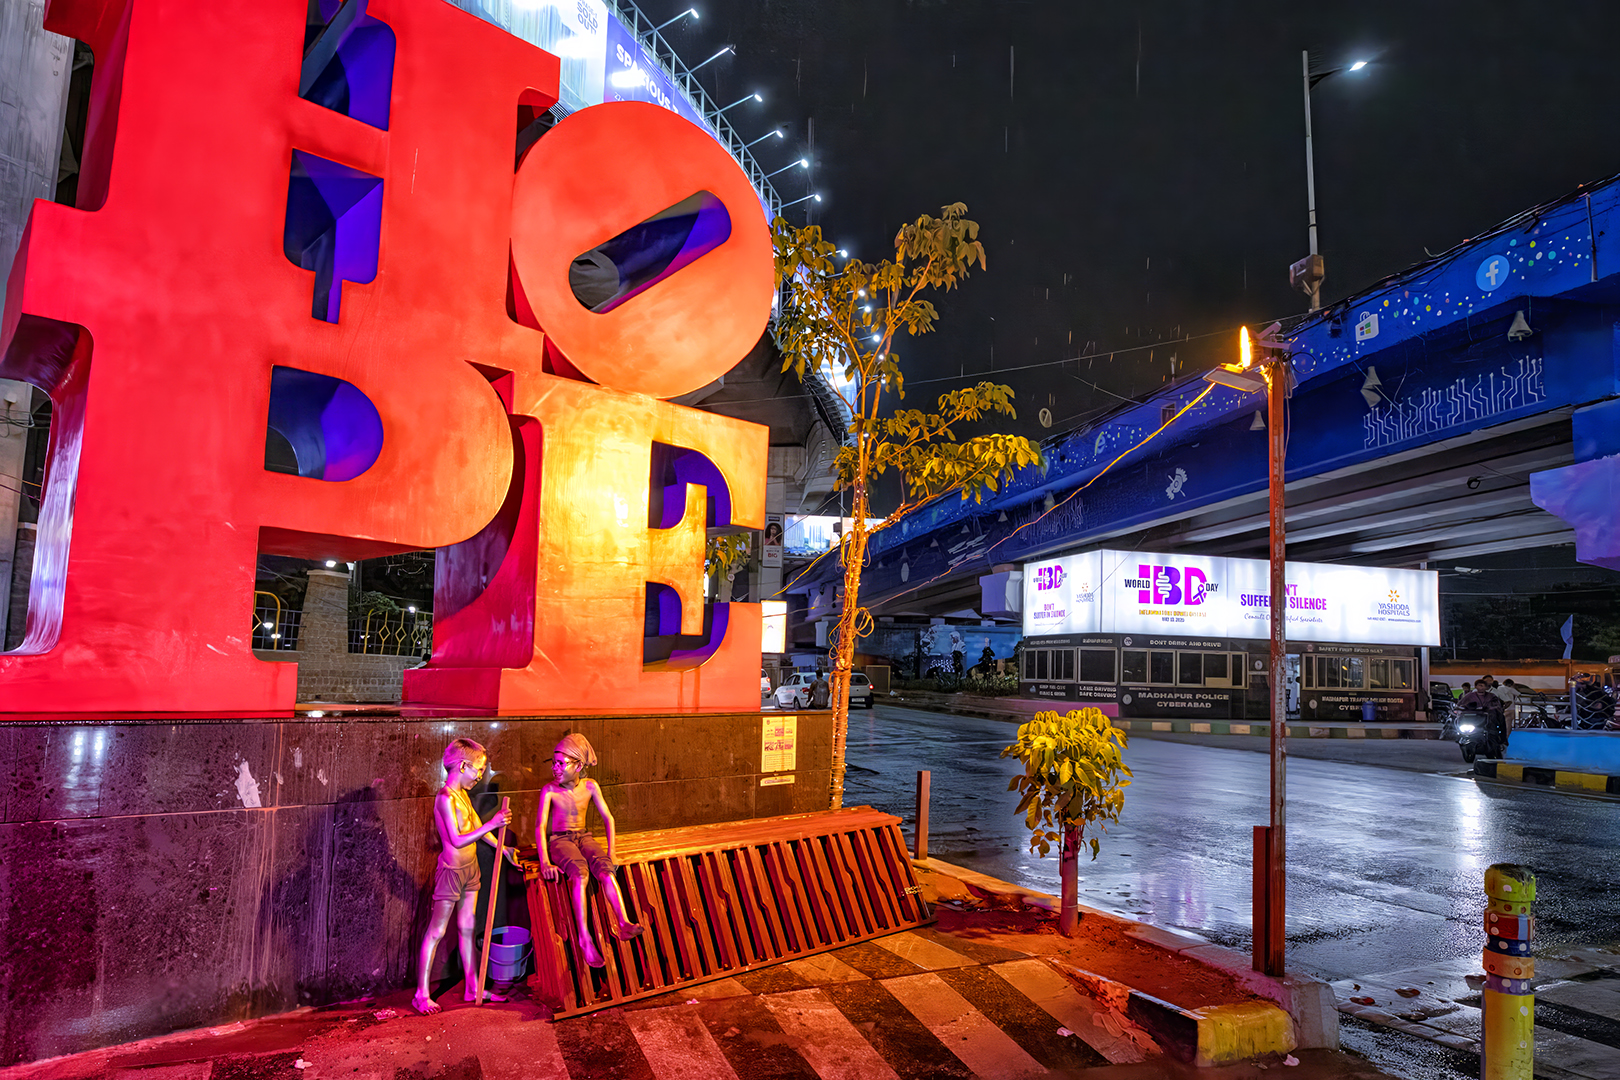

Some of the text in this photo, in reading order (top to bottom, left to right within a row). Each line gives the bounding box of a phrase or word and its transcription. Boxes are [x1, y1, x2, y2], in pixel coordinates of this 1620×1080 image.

[576, 1, 598, 29] SOLD
[616, 43, 671, 111] SPAIOUS
[1124, 564, 1219, 606] WORLD IBD DAY
[1284, 583, 1298, 596] N'T
[1240, 593, 1272, 608] SUFFE
[1289, 596, 1328, 611] SILENCE
[1377, 602, 1410, 610] YASHODA
[1377, 609, 1411, 617] HOSPITALS
[1138, 692, 1230, 701] MADHAPUR POLICE
[1156, 701, 1212, 709] CYBERABAD
